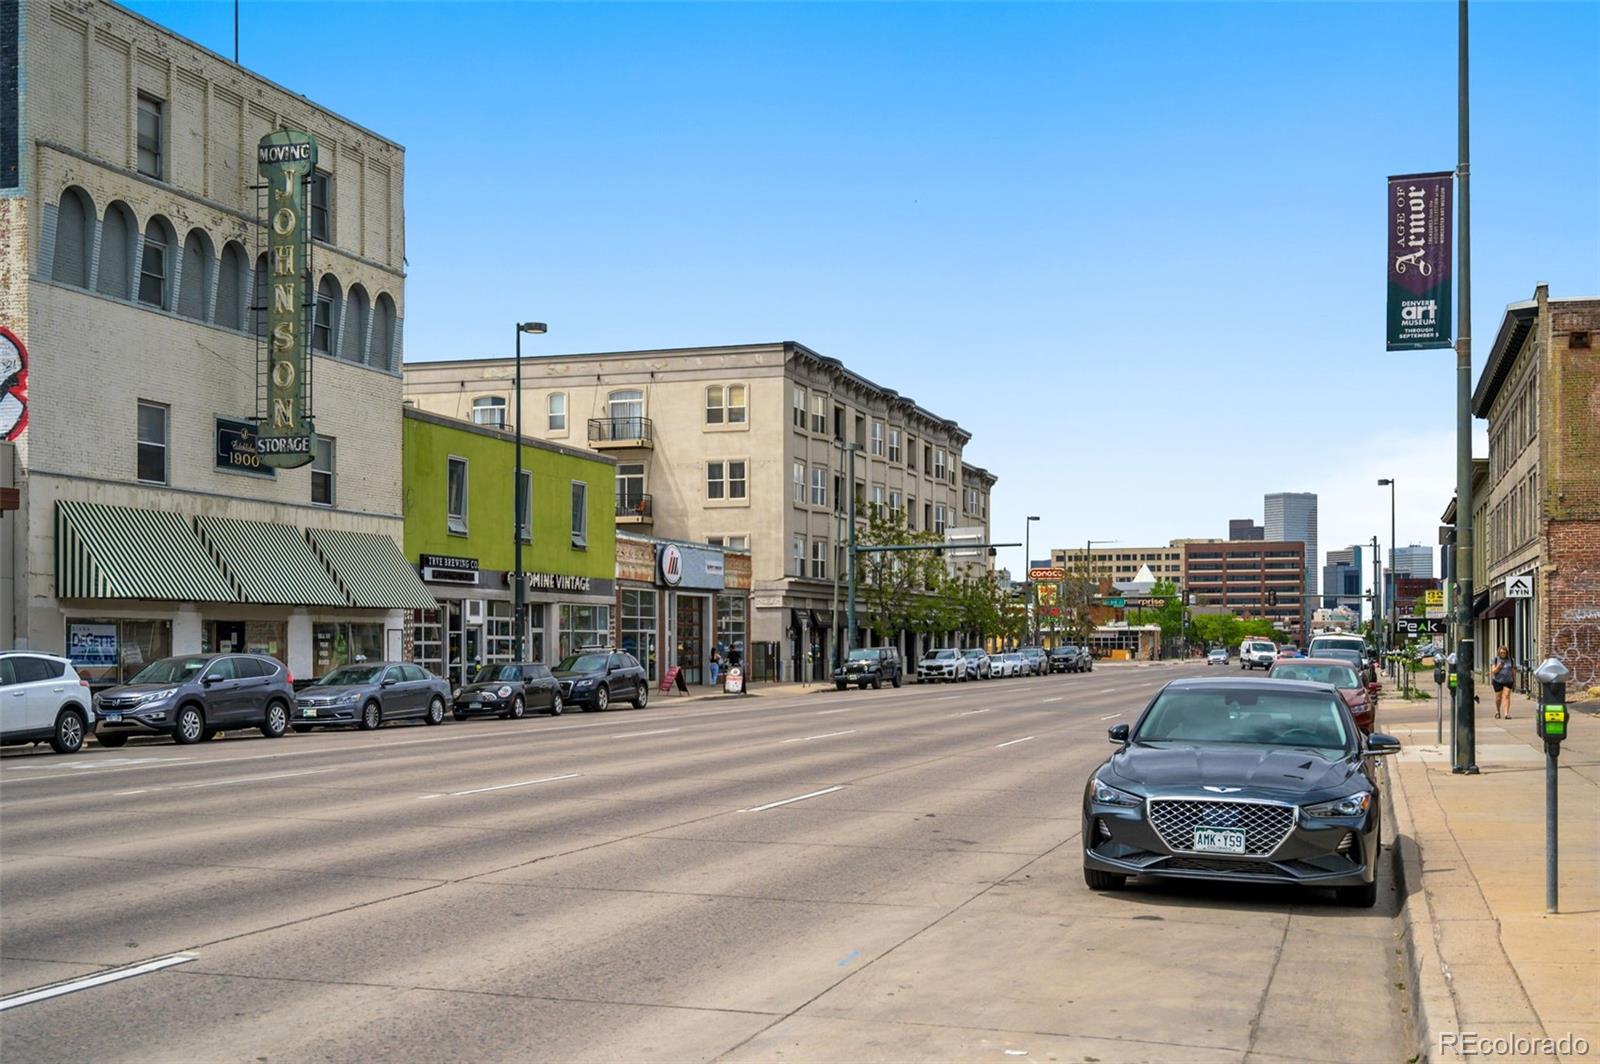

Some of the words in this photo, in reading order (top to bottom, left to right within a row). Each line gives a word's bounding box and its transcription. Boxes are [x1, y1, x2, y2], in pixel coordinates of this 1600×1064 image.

[259, 144, 310, 161] MOVING
[1397, 186, 1406, 208] OF
[1396, 185, 1432, 276] Armor
[1397, 213, 1406, 248] AGE
[273, 169, 296, 429] JOHNSON
[1401, 300, 1438, 320] art
[1401, 318, 1436, 326] MUSEUM
[257, 437, 310, 453] STORAGE
[229, 451, 260, 468] 1900
[444, 557, 470, 569] BREWING
[555, 574, 591, 592] VINTAGE
